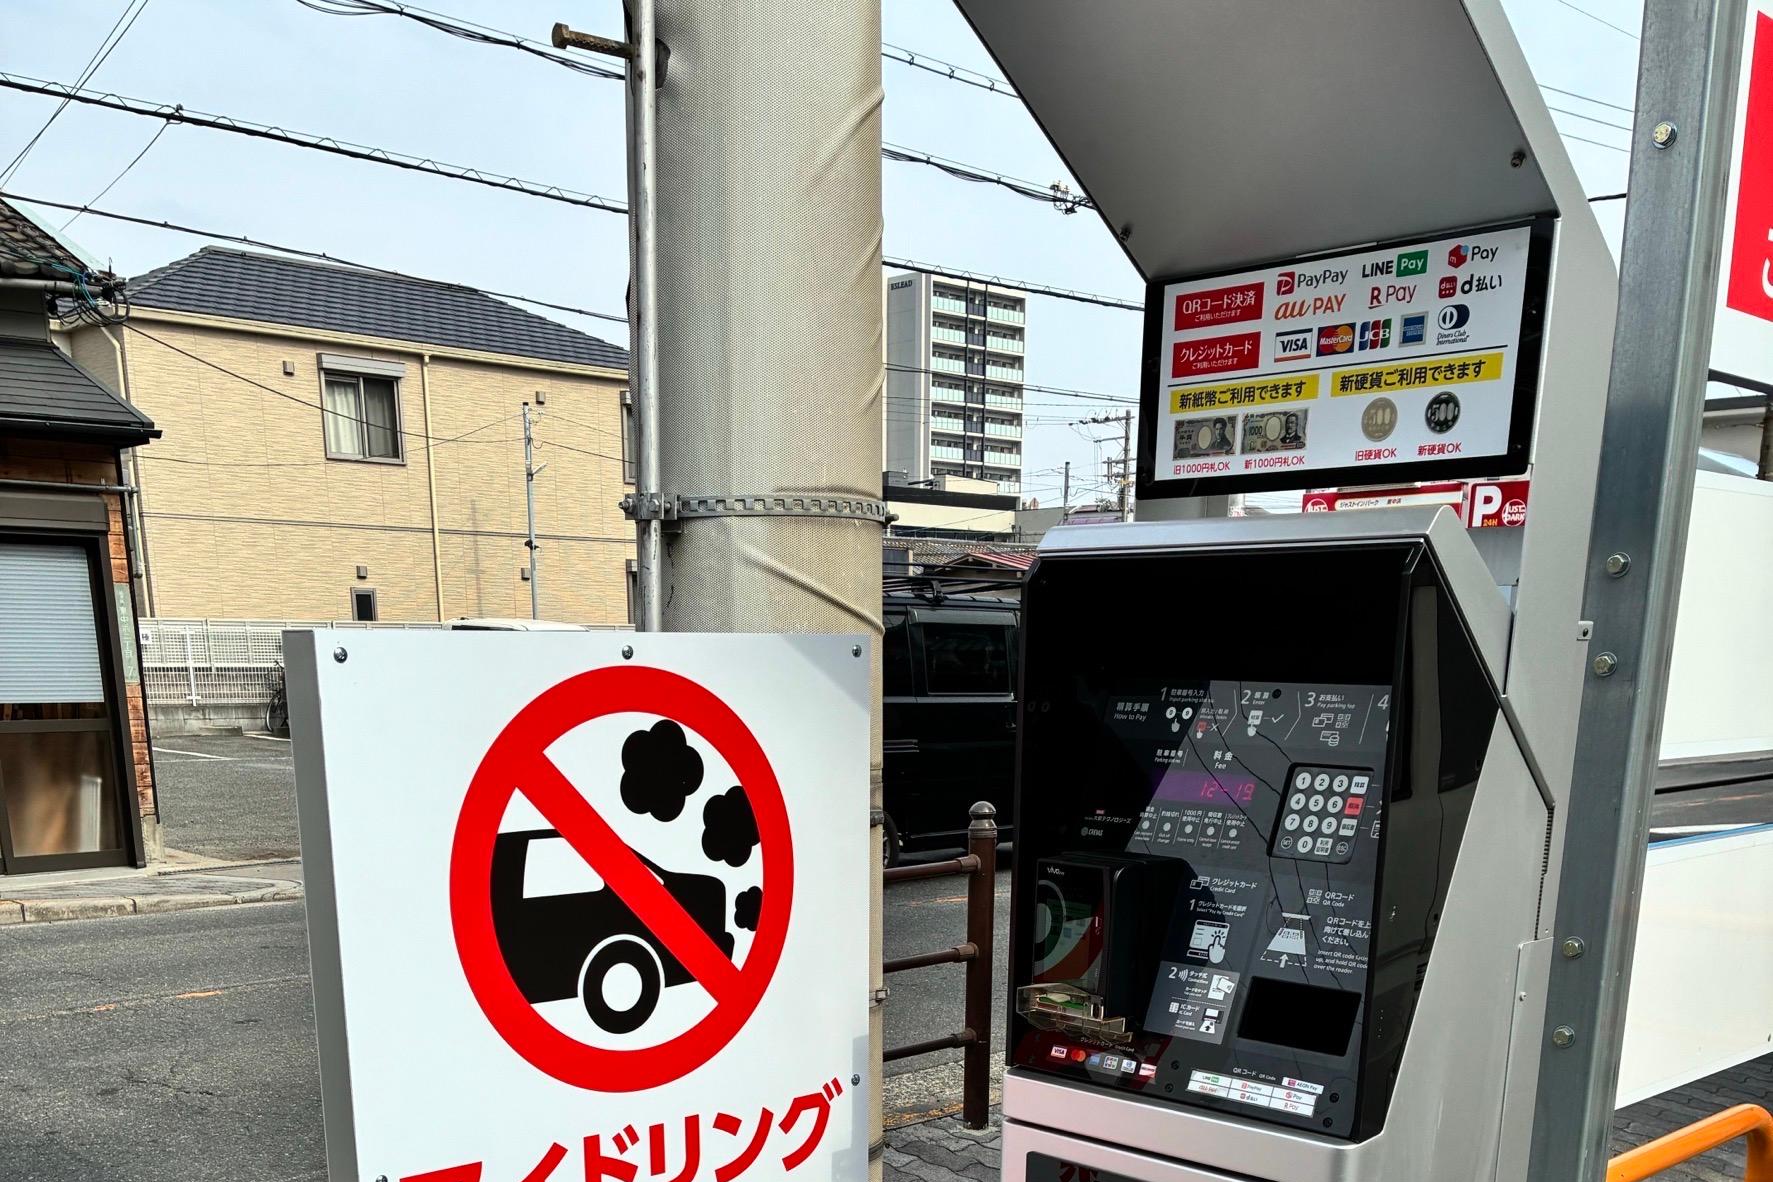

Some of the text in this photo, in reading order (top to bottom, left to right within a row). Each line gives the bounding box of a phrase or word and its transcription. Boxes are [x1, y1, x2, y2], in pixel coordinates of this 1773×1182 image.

[1471, 246, 1499, 263] Pay
[1362, 258, 1425, 278] LINE Pay
[1297, 269, 1348, 288] PayPay
[1461, 274, 1502, 294] d払い
[1386, 284, 1417, 304] Pay
[1182, 290, 1256, 315] QRコード決済
[1274, 294, 1346, 320] au PAY
[1319, 334, 1352, 345] MasterCard
[1359, 328, 1391, 342] JCB
[1180, 340, 1253, 363] クレジットカード
[1280, 337, 1308, 353] VISA
[1339, 359, 1486, 392] 新硬貨ご利用できます
[1179, 380, 1306, 410] 新紙幣ご利用できます
[1355, 447, 1397, 462] 旧硬貨OK
[1417, 442, 1462, 457] 新硬貨OK
[1174, 461, 1231, 475] 旧1000円札OK
[1244, 455, 1305, 470] 新1000円札OK
[1472, 485, 1502, 528] P
[1241, 690, 1251, 705] 2
[1304, 692, 1316, 707] 3
[1377, 694, 1389, 710] 4
[1213, 750, 1233, 761] 料金
[1212, 878, 1258, 889] クレジットカード
[1325, 891, 1355, 901] QRコード
[1190, 899, 1196, 911] 1
[1168, 966, 1178, 979] 2
[1054, 1048, 1065, 1056] VISA
